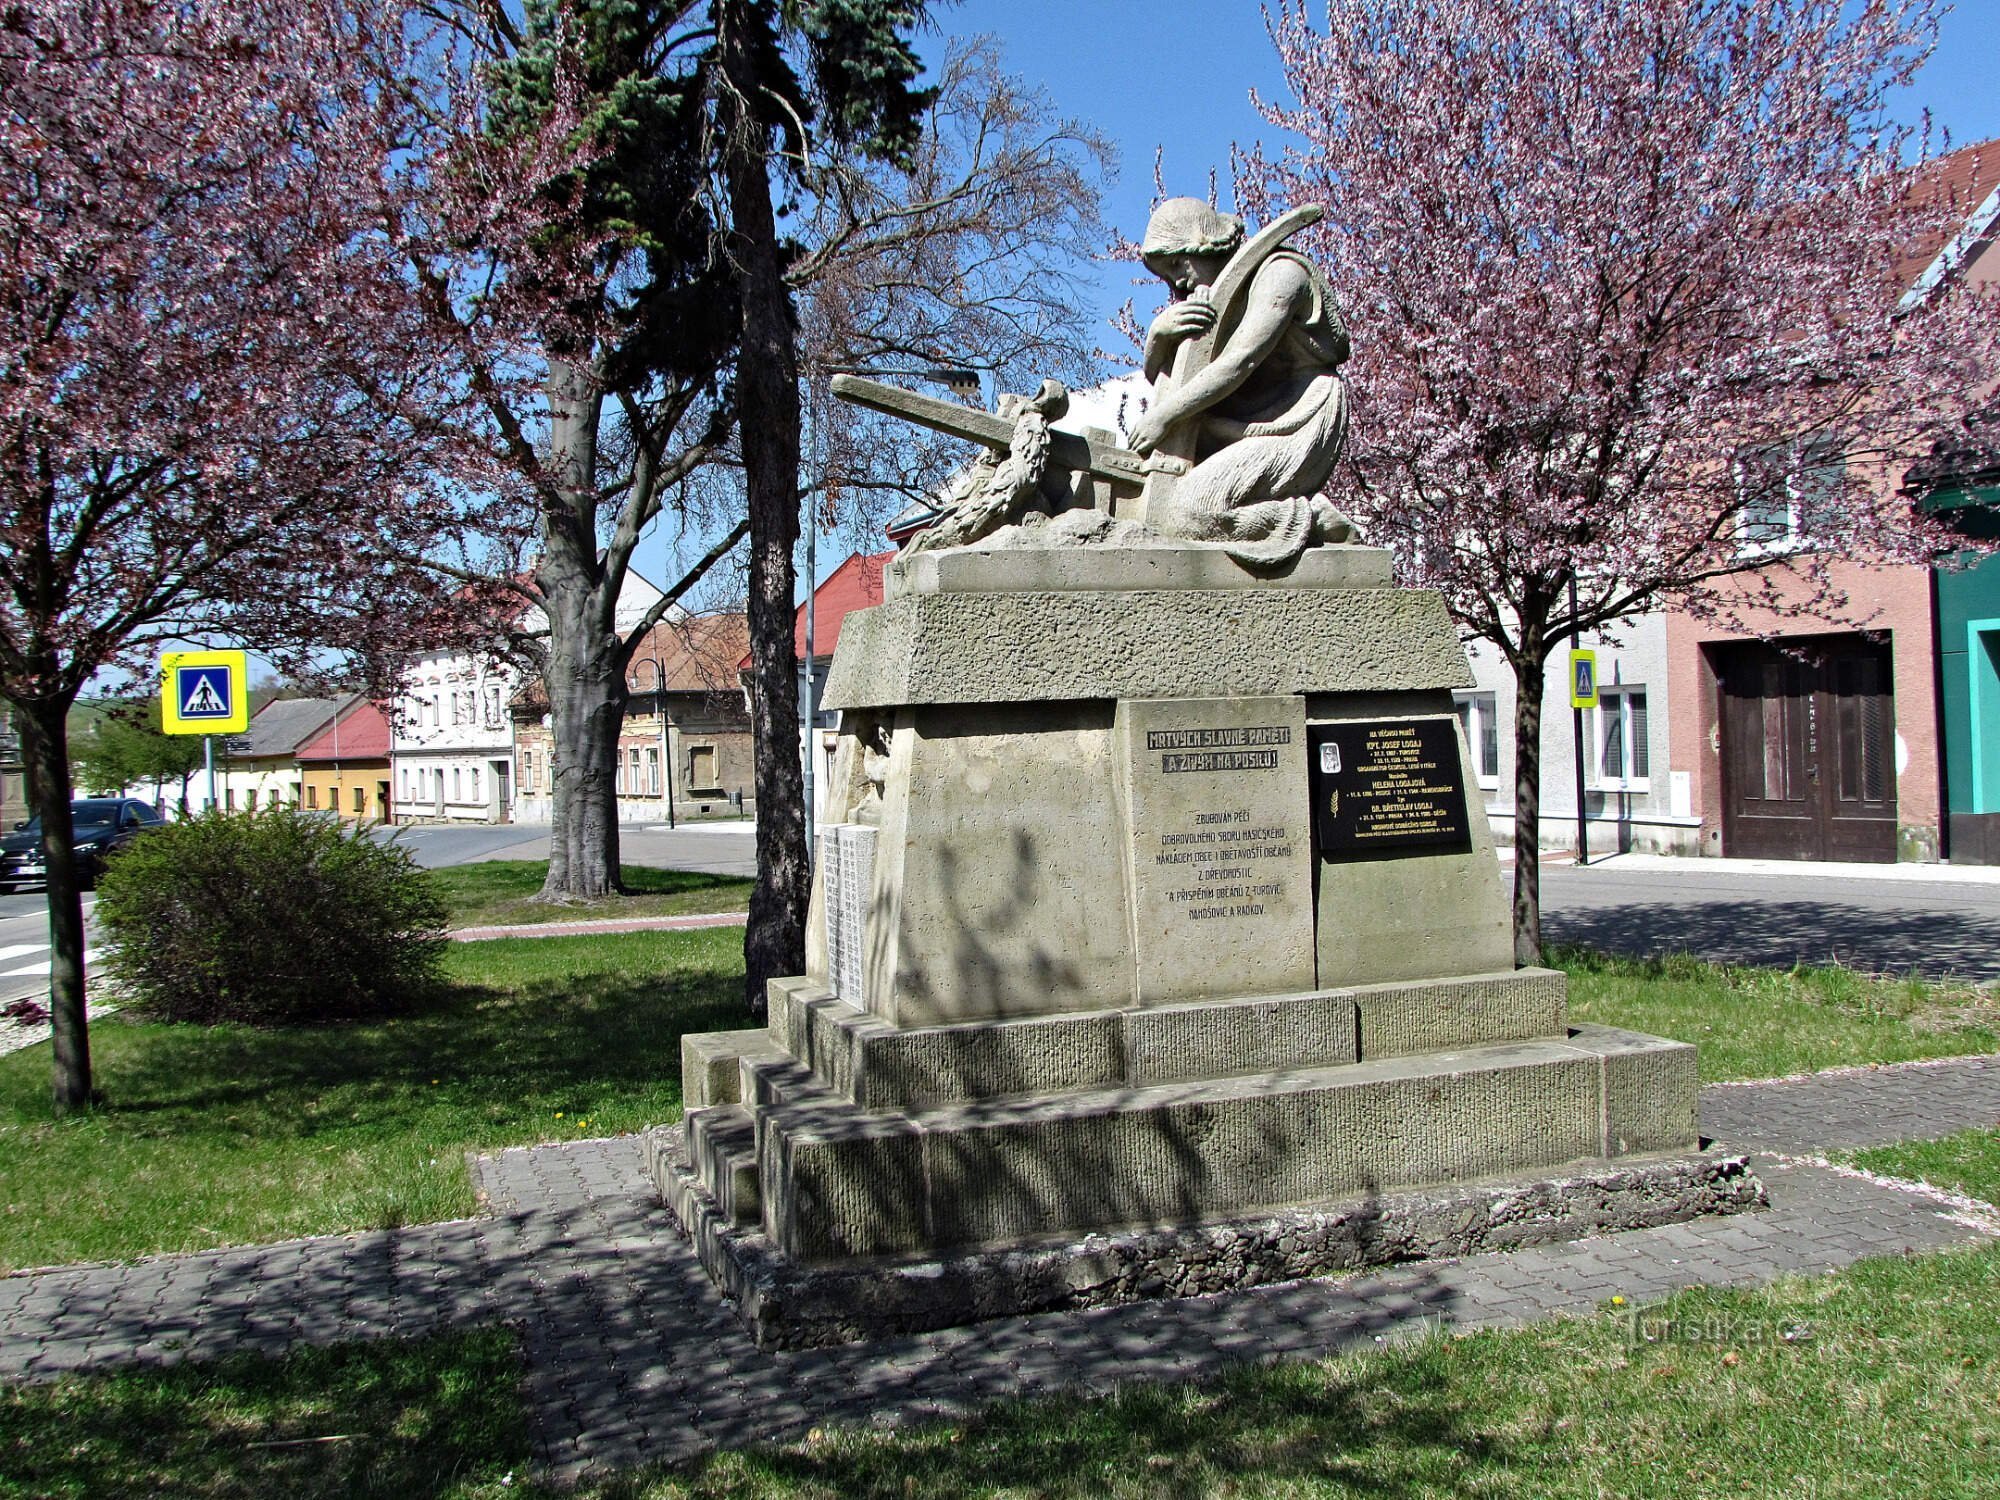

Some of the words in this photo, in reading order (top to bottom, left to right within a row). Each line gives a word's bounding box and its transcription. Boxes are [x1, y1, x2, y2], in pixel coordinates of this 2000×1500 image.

[1149, 731, 1200, 747] MRTVÝCH
[1168, 756, 1176, 771] A
[1216, 754, 1230, 769] NA
[1235, 750, 1276, 768] POSILU!
[1372, 780, 1395, 789] HELENA
[1161, 830, 1216, 845] DOBROVOLNÉHO
[1218, 831, 1240, 842] SBORU
[1195, 851, 1212, 862] OBCE
[1198, 871, 1203, 881] Z
[1205, 867, 1252, 880] DŘEVOHOSTIC
[1169, 891, 1174, 901] A
[1176, 887, 1214, 902] PŘISPĚNÍM
[1216, 885, 1243, 899] OBČANŮ
[1246, 886, 1250, 896] Z
[1189, 906, 1227, 920] NAHOŠOVIC
[1230, 907, 1234, 916] A
